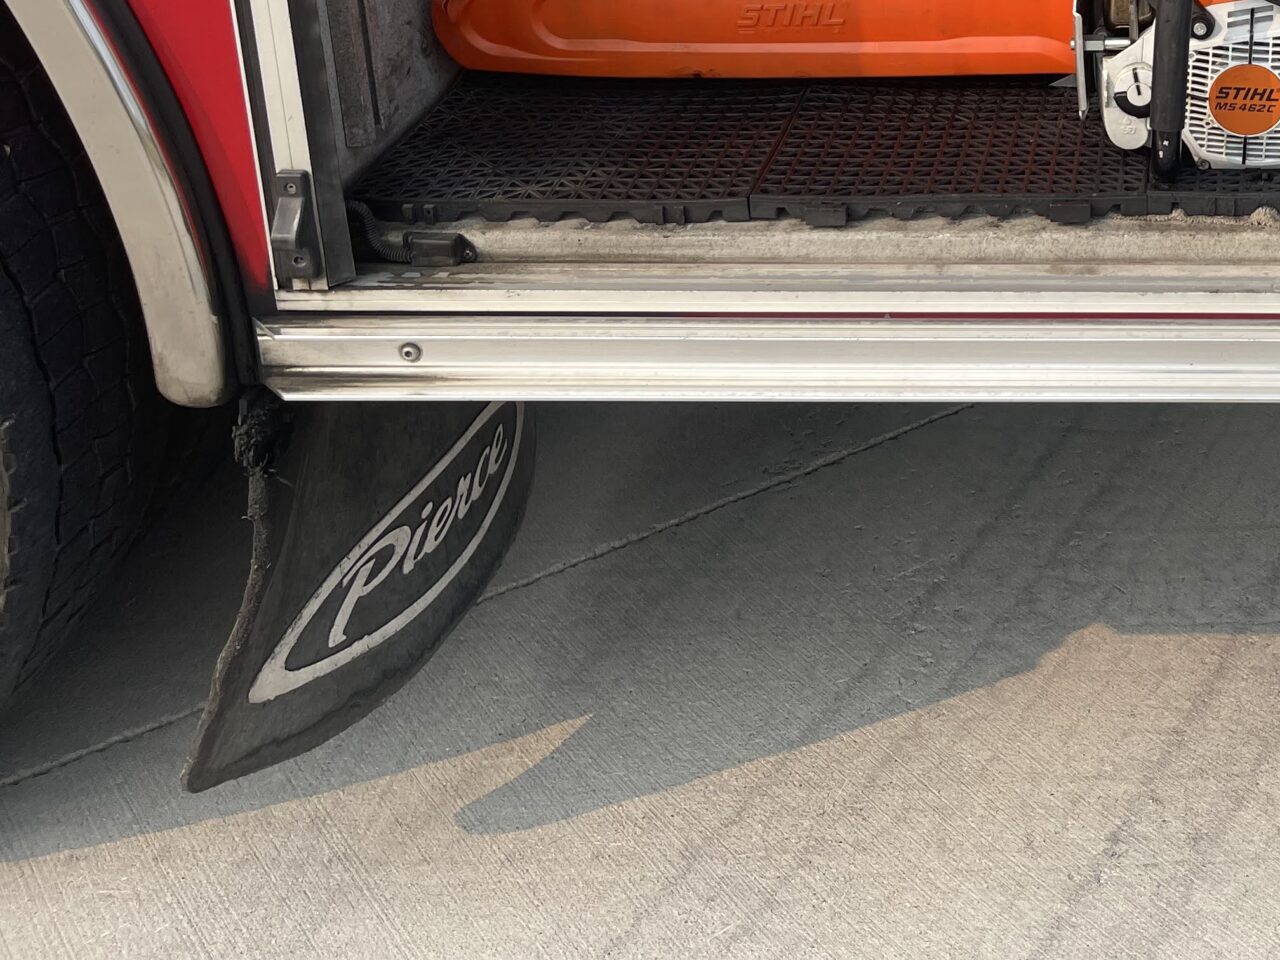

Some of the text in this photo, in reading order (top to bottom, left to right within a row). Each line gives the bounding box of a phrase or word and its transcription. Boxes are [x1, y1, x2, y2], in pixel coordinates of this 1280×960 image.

[737, 3, 846, 28] STIHL
[1215, 86, 1280, 102] STIHL
[328, 424, 508, 648] Pierce
